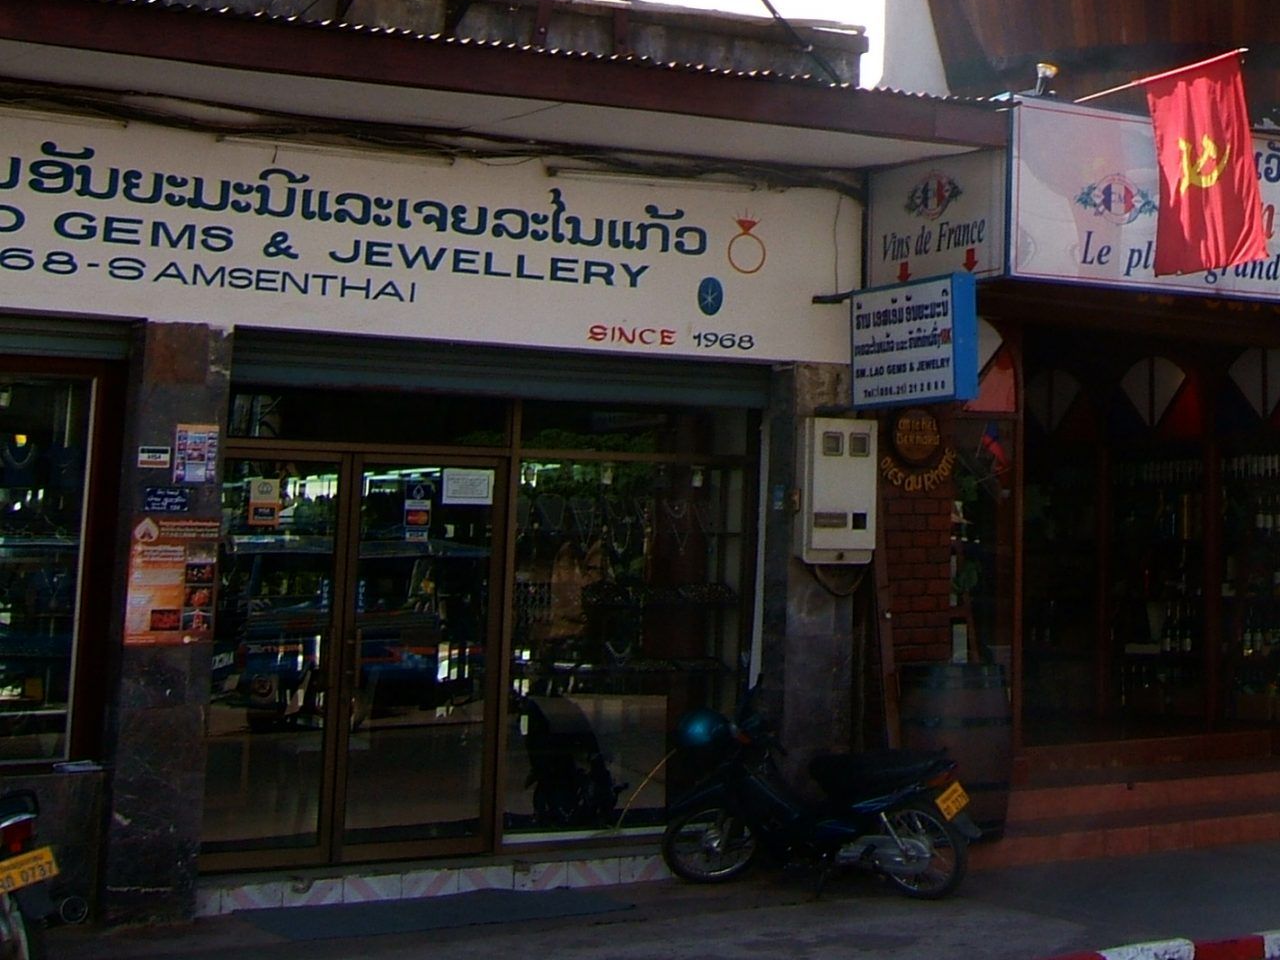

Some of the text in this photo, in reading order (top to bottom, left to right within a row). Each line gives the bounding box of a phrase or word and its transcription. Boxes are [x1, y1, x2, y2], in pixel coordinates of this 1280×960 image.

[53, 211, 235, 253] GEMS
[262, 231, 299, 260] &
[329, 239, 650, 289] JEWELLERY
[882, 217, 986, 263] Vins de France
[1082, 230, 1112, 266] Le
[1124, 240, 1156, 278] pl
[587, 324, 756, 351] SINCE 1968
[886, 362, 907, 375] GEMS
